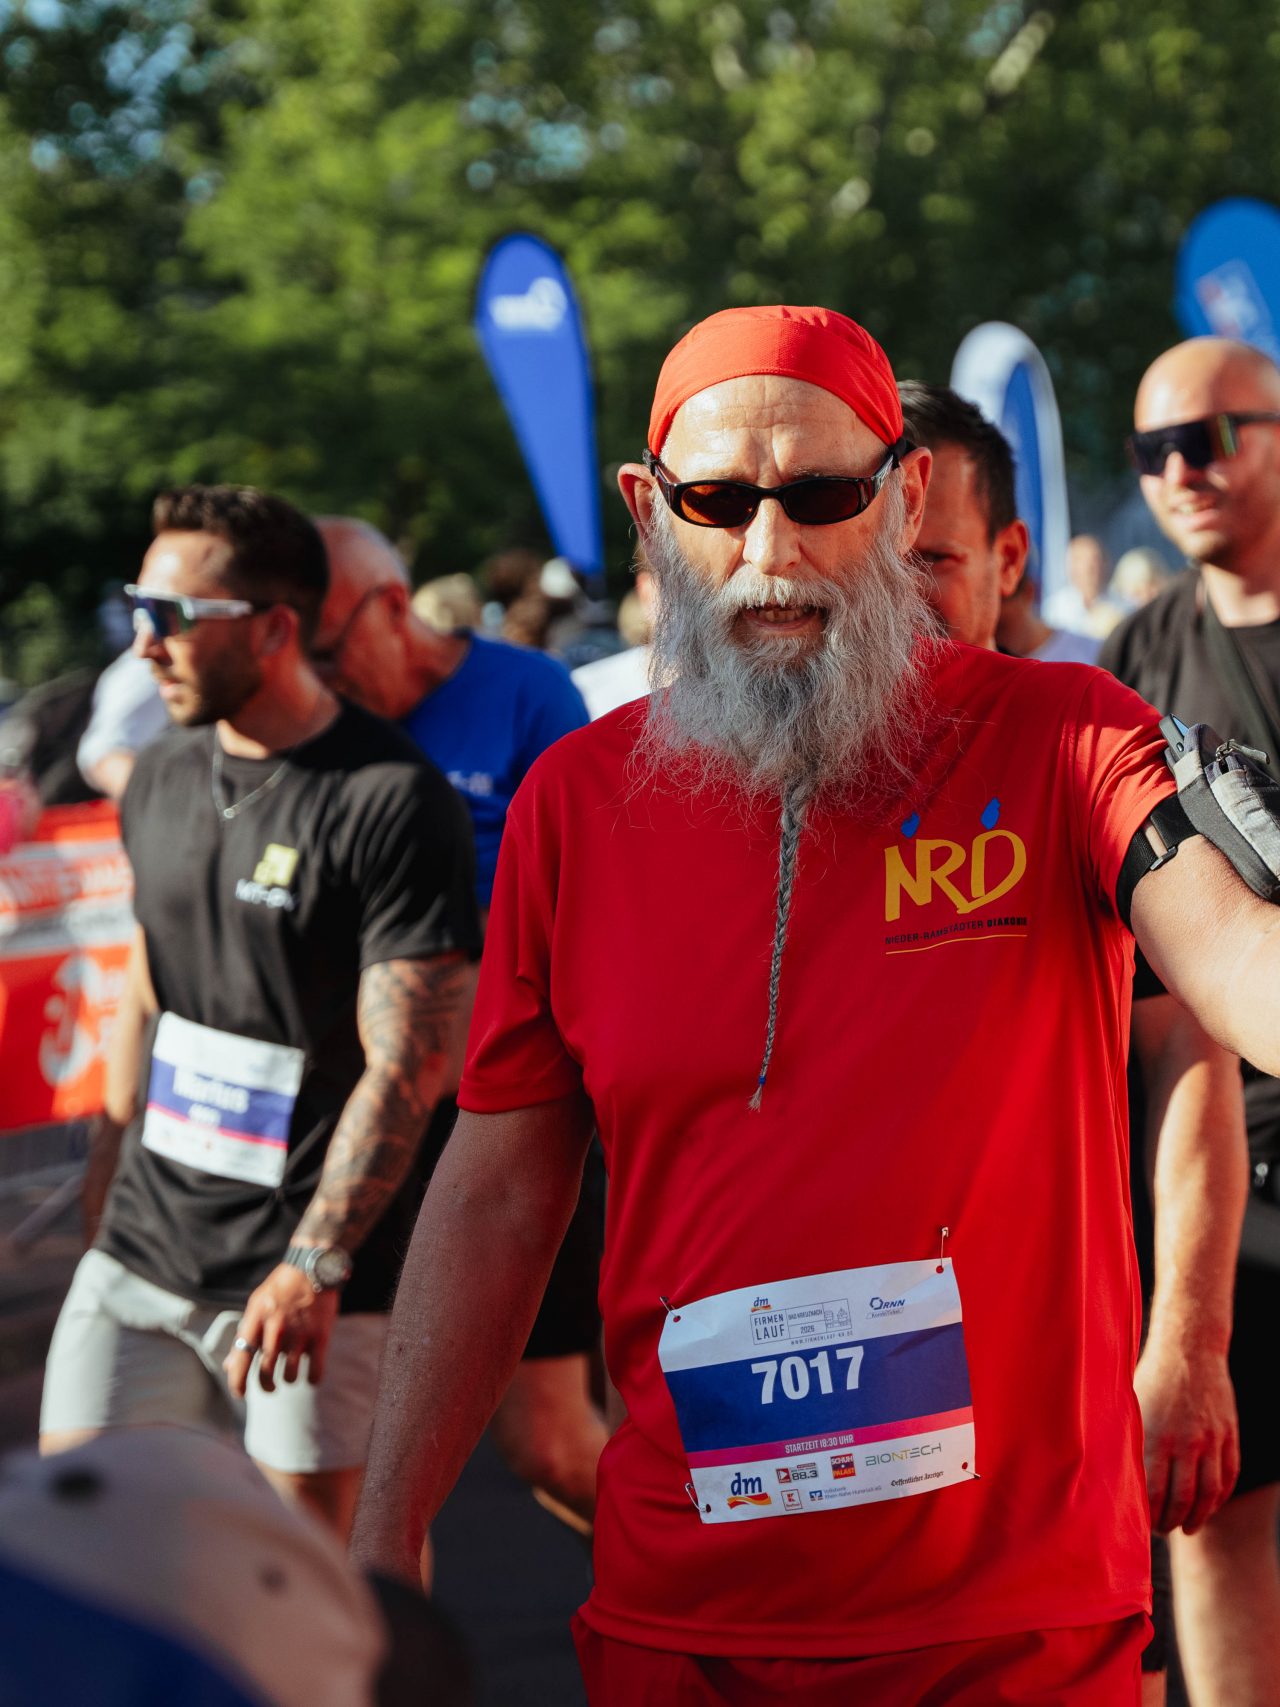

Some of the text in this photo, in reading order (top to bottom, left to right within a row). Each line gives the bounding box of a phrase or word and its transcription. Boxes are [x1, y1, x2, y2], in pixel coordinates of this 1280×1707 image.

[885, 830, 1027, 922] NRD
[753, 1296, 769, 1307] dm
[754, 1313, 784, 1327] FIRMEN
[755, 1324, 785, 1341] LAUF
[751, 1345, 865, 1405] 7017
[784, 1433, 855, 1454] STARTZEIT 18:30 UHR
[831, 1455, 854, 1465] SCHUH
[865, 1442, 942, 1467] BIONTECH
[791, 1469, 818, 1481] 88.3
[832, 1467, 855, 1478] PALAST
[730, 1472, 763, 1496] dm
